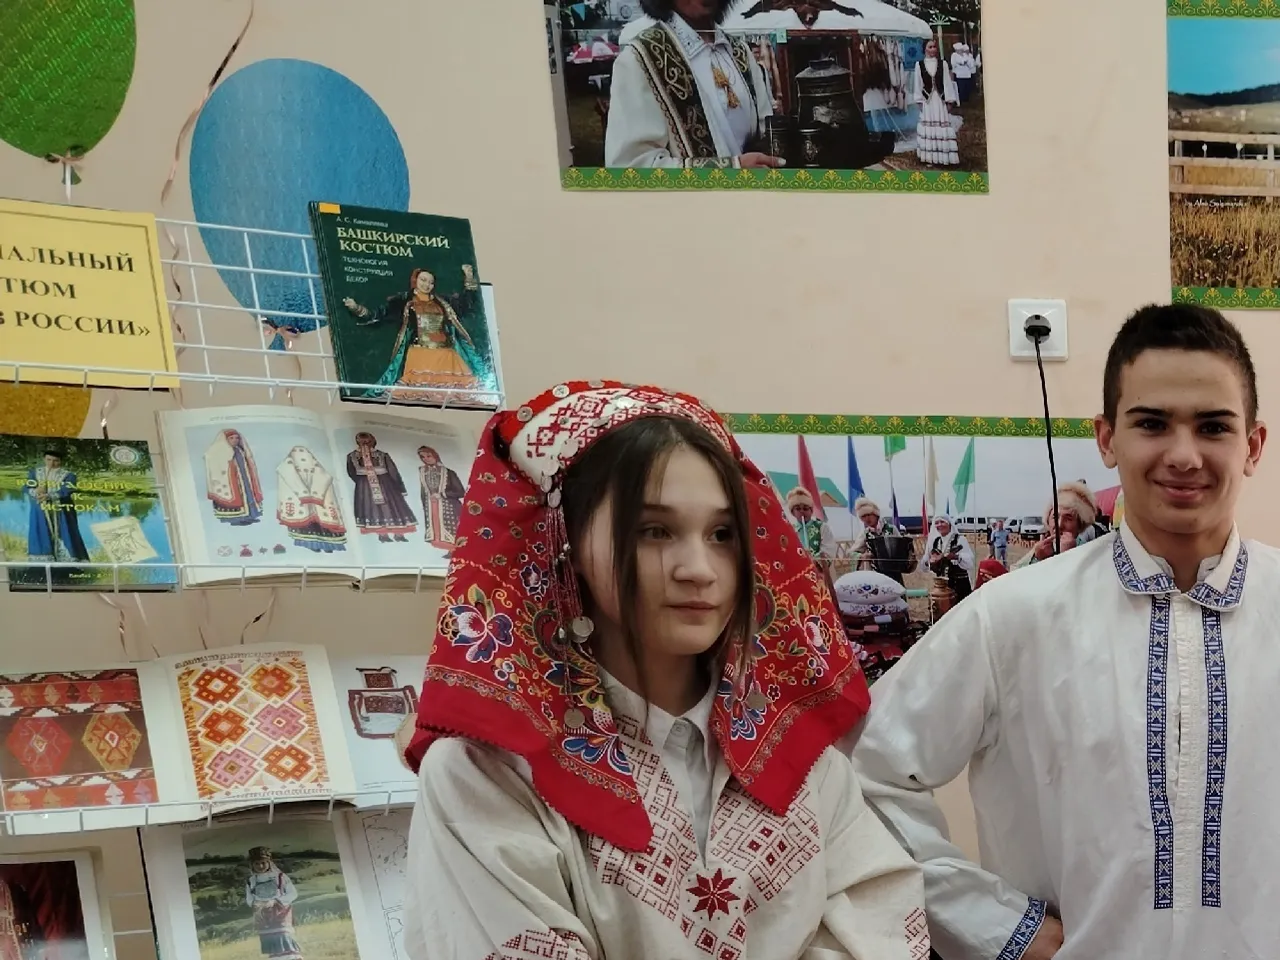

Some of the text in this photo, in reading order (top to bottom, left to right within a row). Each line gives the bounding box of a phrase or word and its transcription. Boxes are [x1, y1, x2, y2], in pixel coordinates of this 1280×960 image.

[336, 227, 450, 249] БАШКИРСКИЙ
[340, 240, 414, 258] КОСТЮМ
[0, 244, 136, 273] АЛЬНЫЙ
[14, 311, 150, 336] РОССИИ»
[40, 503, 121, 513] ИСТОКАМ
